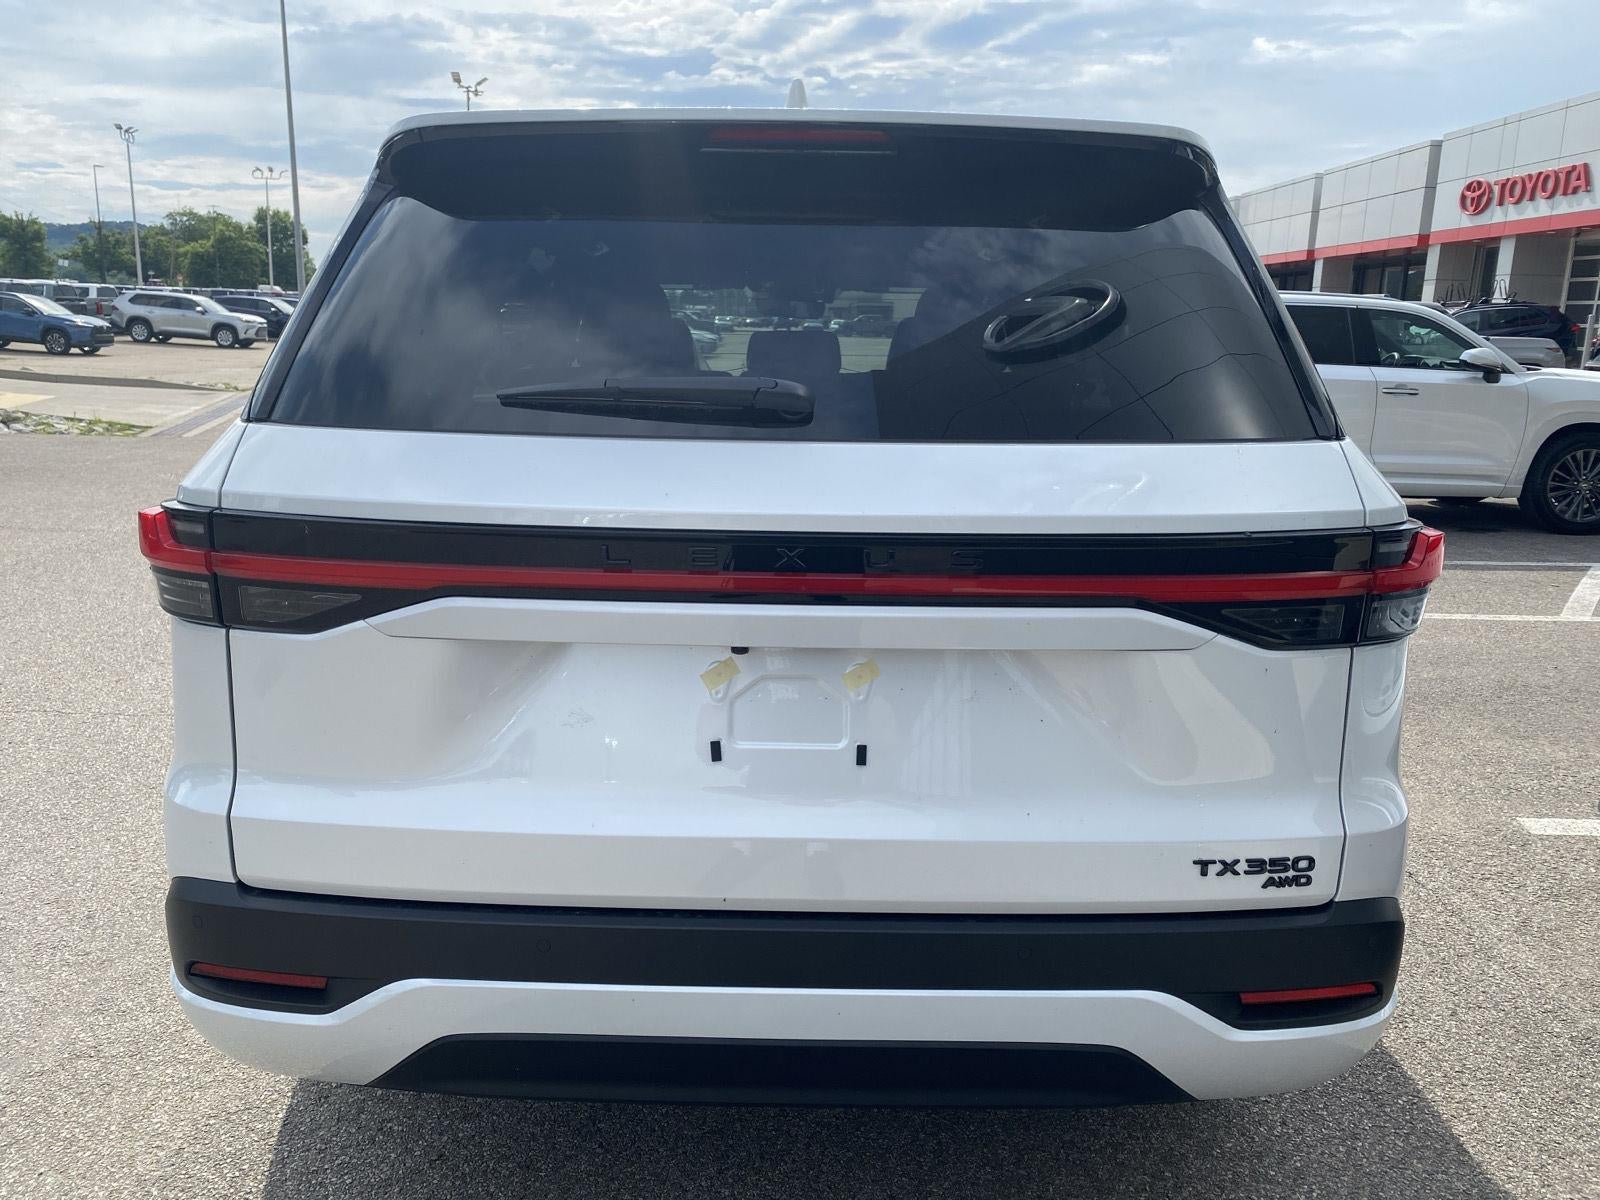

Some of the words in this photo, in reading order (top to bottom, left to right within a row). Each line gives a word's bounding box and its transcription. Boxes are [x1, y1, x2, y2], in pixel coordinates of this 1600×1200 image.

[1494, 162, 1591, 206] TOYOTA
[601, 543, 984, 568] LEXUS
[1261, 874, 1313, 889] AWD
